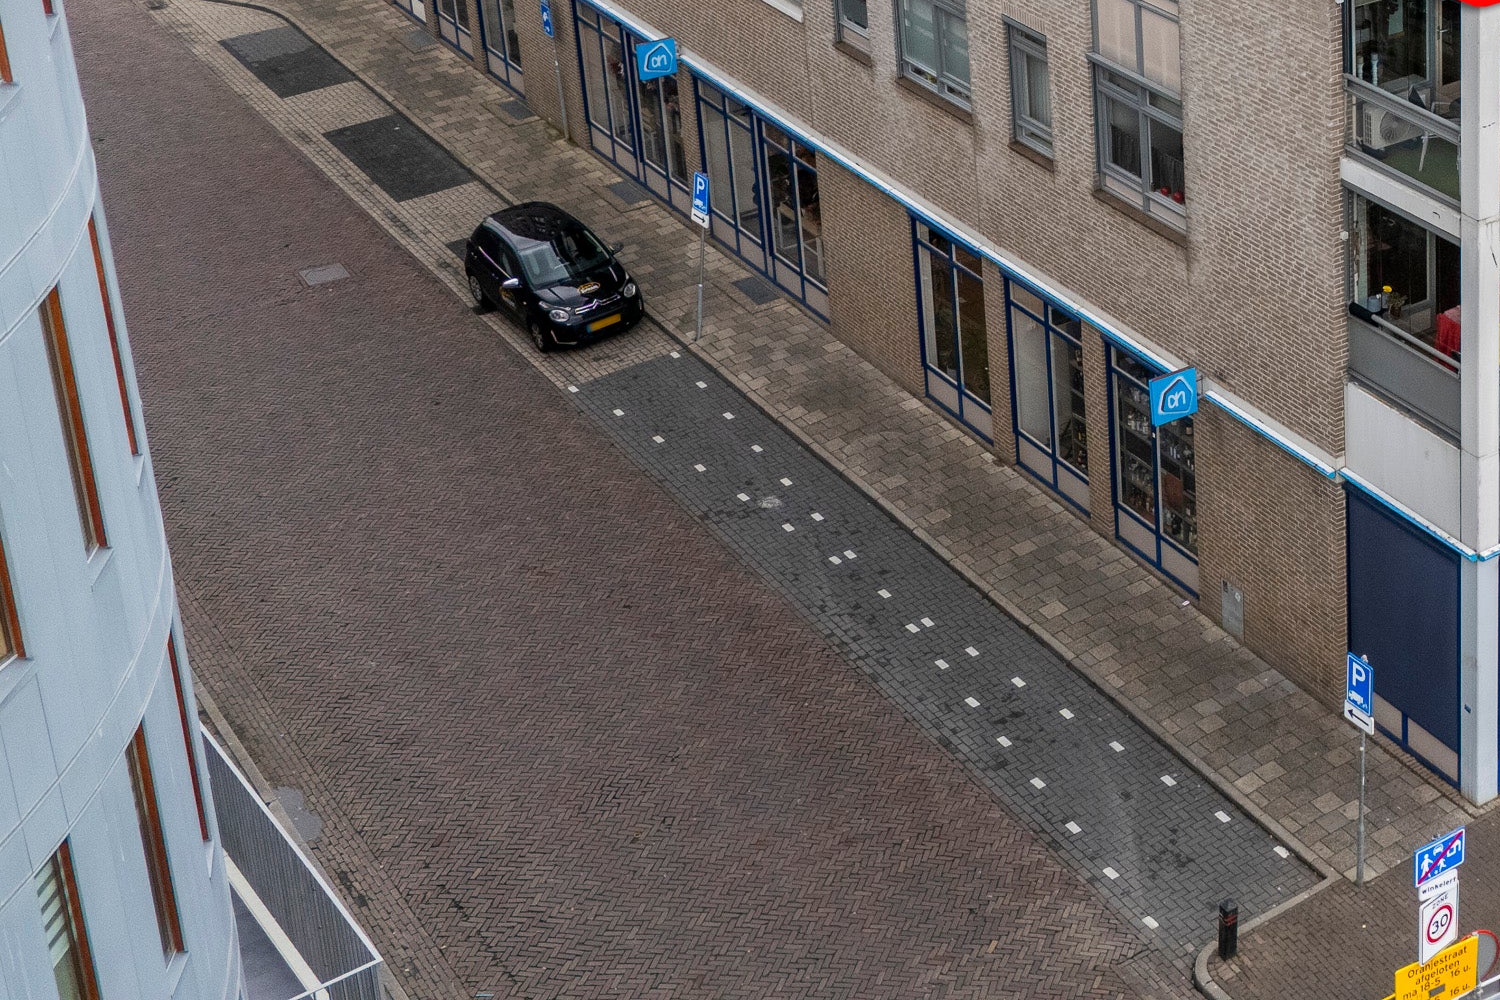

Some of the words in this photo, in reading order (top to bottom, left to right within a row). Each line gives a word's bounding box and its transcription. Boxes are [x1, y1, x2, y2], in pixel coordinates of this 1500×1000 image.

[697, 176, 705, 195] P
[1352, 661, 1366, 687] P
[1421, 876, 1457, 895] winkelerf
[1432, 893, 1449, 910] ZONE
[1431, 913, 1449, 935] 30
[1407, 945, 1467, 979] Oranjestraat
[1450, 967, 1460, 978] 16
[1450, 986, 1460, 997] 16
